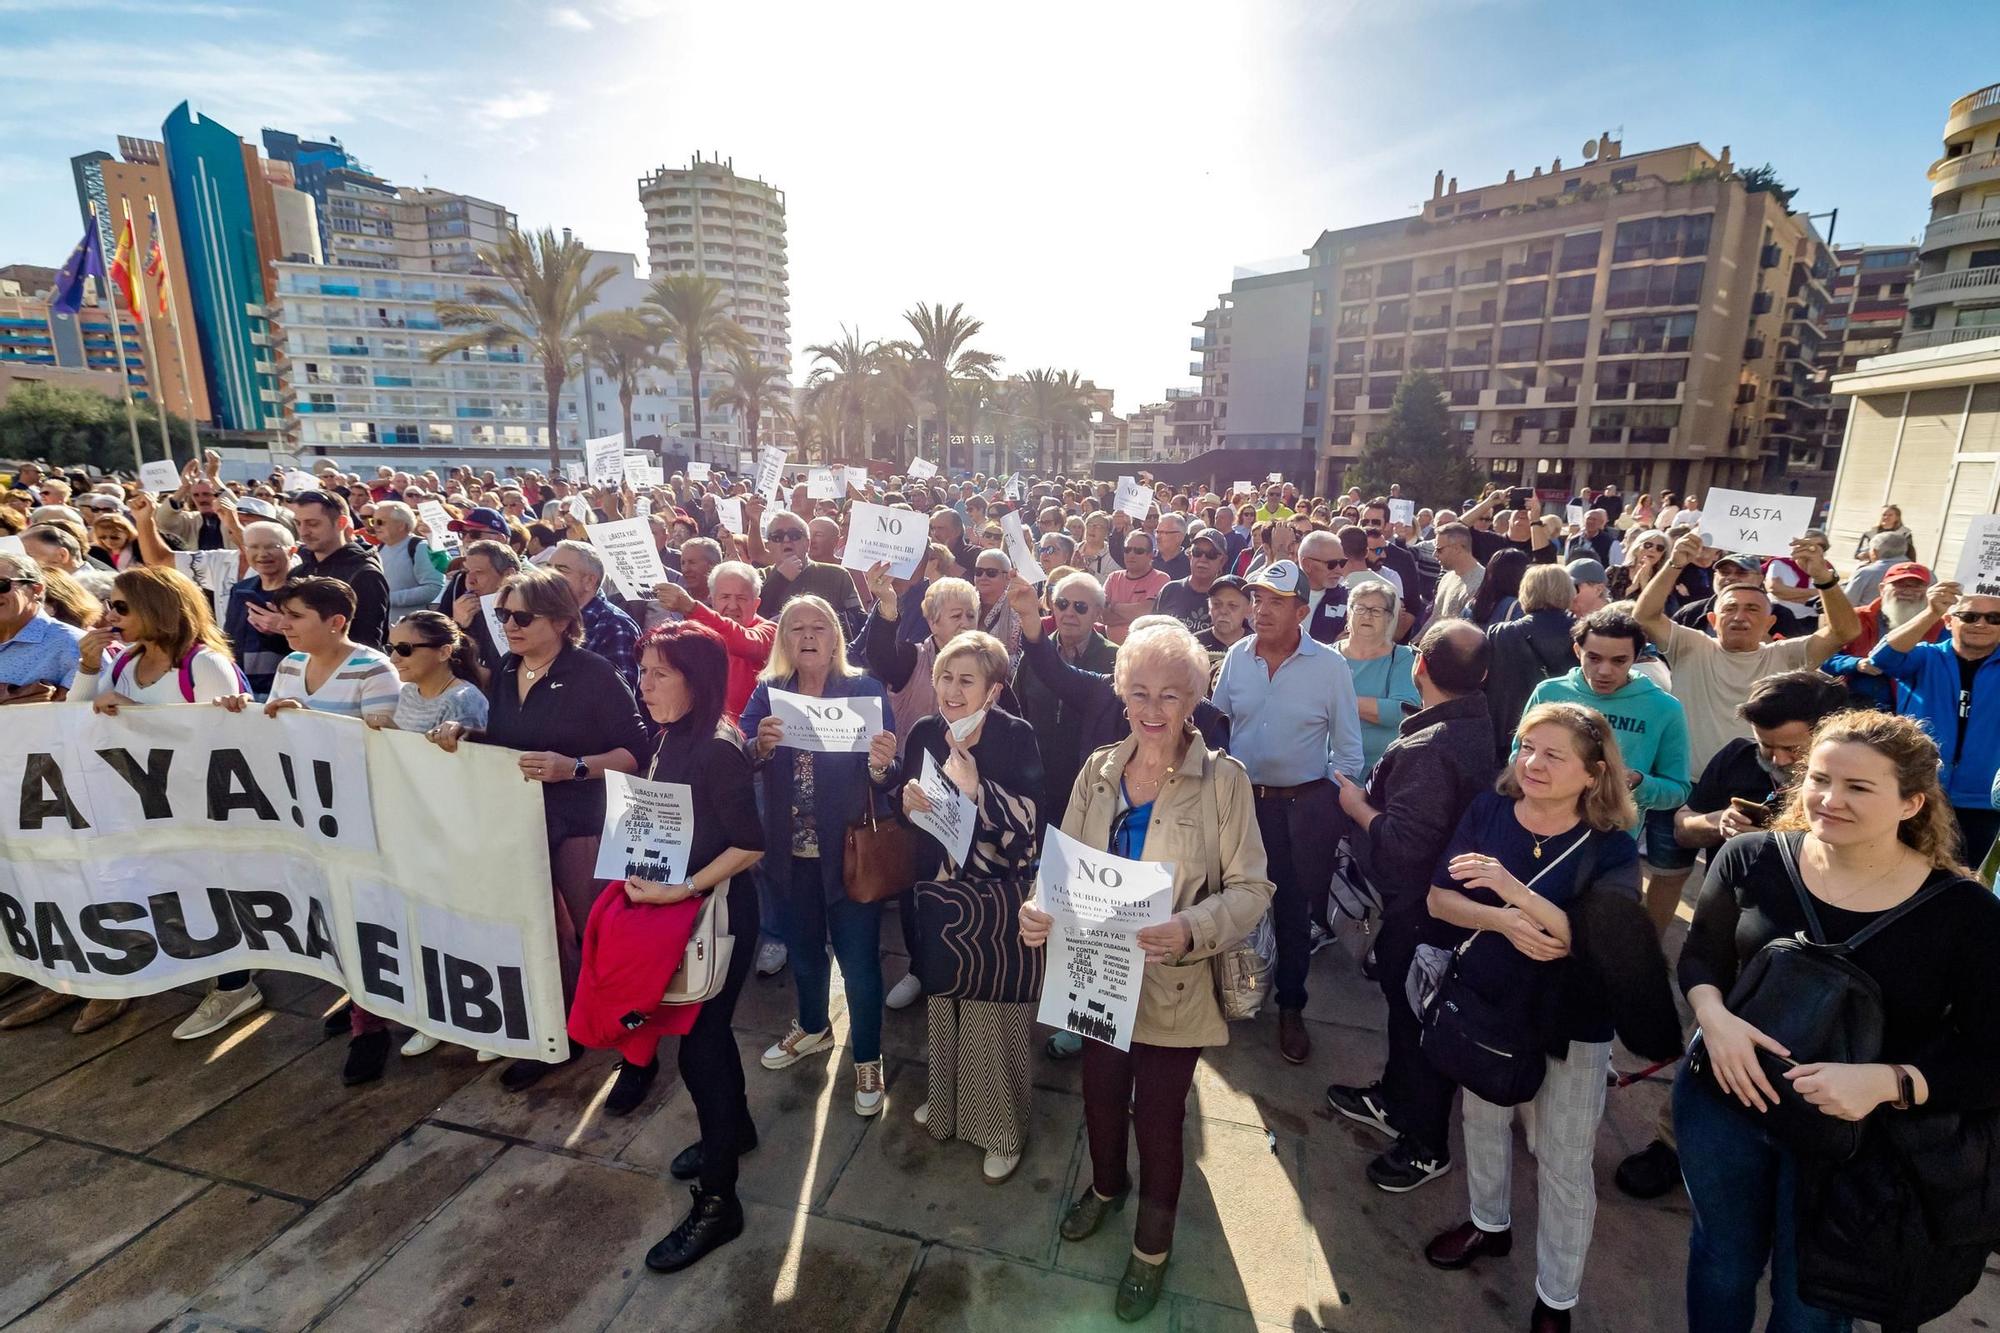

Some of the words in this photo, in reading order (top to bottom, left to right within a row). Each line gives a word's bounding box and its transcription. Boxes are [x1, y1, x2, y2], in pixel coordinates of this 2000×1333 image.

[818, 474, 840, 482] BASTA
[1729, 505, 1782, 521] BASTA
[876, 516, 903, 536] NO
[1739, 528, 1759, 542] YA
[806, 705, 843, 720] NO
[96, 748, 339, 838] YA!!
[1077, 858, 1123, 888] NO
[1059, 885, 1070, 896] LA
[1072, 890, 1108, 904] SUBIDA
[1132, 900, 1152, 909] IBI
[1116, 909, 1151, 918] BASURA
[1110, 932, 1126, 941] YA!!!
[1066, 937, 1102, 948] MANIFESTACIÓN
[1103, 942, 1131, 953] CIUDADANA
[1076, 947, 1099, 956] CONTRA
[0, 887, 342, 975] BASURA
[357, 922, 404, 1004] E
[421, 945, 530, 1040] IBI
[1073, 957, 1092, 967] SUBIDA
[1069, 970, 1081, 980] 72%
[1076, 964, 1098, 977] BASURA
[1074, 980, 1086, 990] 23%
[1114, 977, 1127, 986] PLAZA
[1098, 989, 1128, 1002] AYUNTAMIENTO
